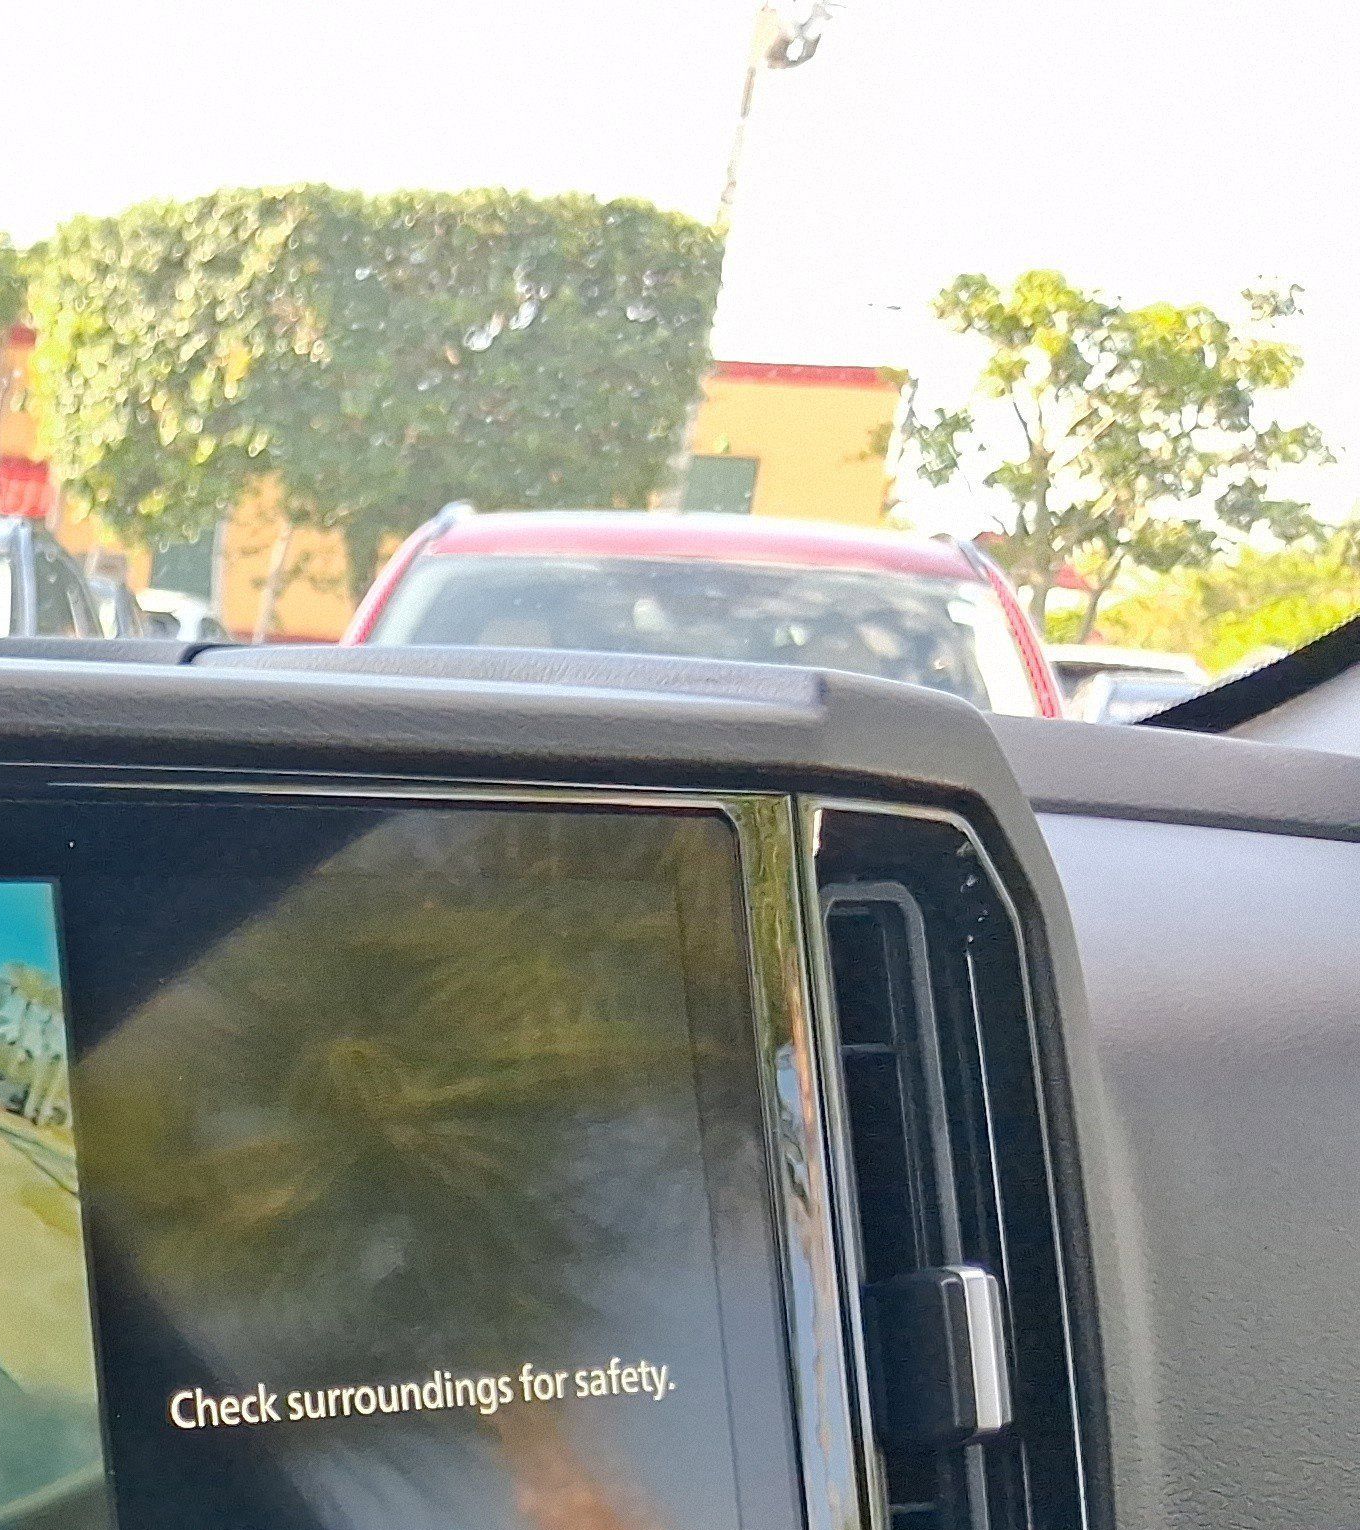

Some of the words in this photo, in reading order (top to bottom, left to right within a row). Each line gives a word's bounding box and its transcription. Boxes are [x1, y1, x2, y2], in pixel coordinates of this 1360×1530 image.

[170, 1383, 281, 1429] Check
[288, 1369, 513, 1421] surroundings
[519, 1362, 567, 1402] for
[576, 1357, 676, 1401] safety.
